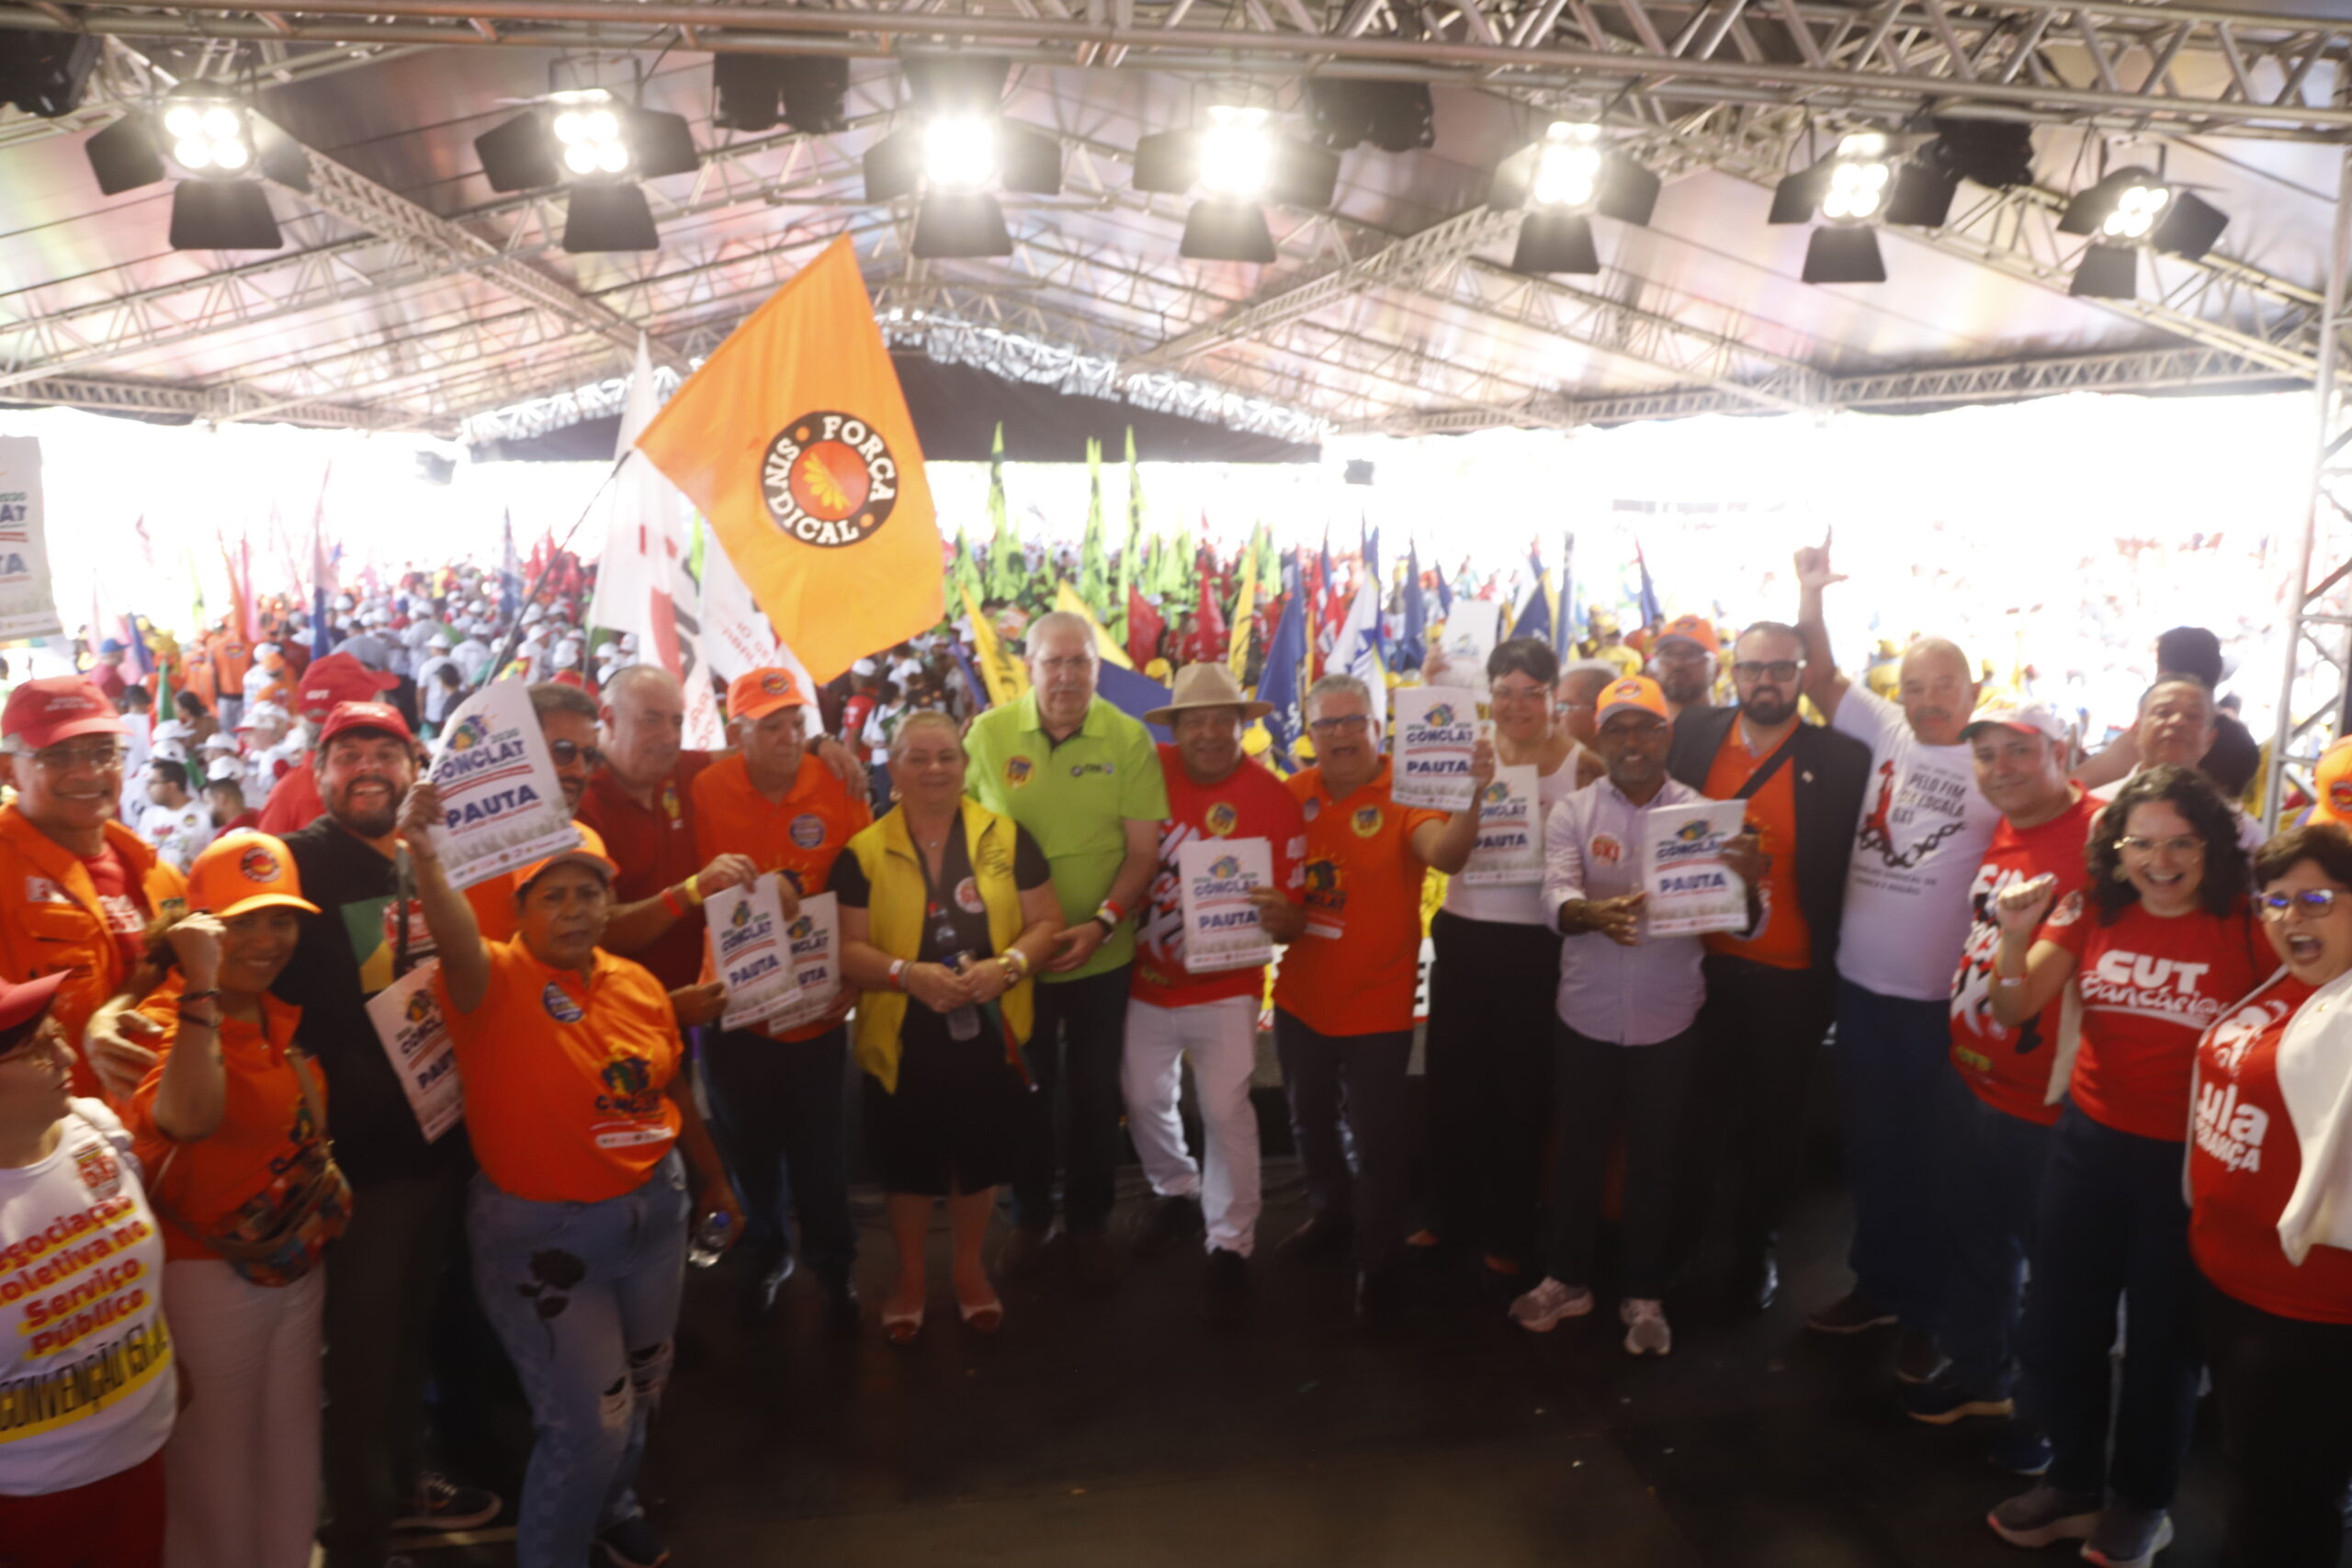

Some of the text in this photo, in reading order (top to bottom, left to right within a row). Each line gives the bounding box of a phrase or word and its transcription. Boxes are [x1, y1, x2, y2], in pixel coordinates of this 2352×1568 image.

[764, 437, 860, 544] SINDICAL
[1407, 730, 1473, 744] CONCLAT
[1407, 760, 1469, 774] PAUTA
[447, 784, 539, 829] PAUTA
[1479, 804, 1528, 818] ONCLAT
[1657, 840, 1719, 860] CONCLA
[1660, 873, 1727, 892] PAUTA
[721, 920, 772, 953] CONCLAT
[1199, 910, 1259, 930] PAUTA
[790, 937, 829, 954] NCLAT
[729, 953, 780, 987] PAUTA
[797, 965, 828, 986] UTA
[2097, 949, 2211, 994] CUT
[416, 1045, 455, 1090] PAUT
[2198, 1082, 2270, 1147] ula
[0, 1196, 133, 1271] sociação
[0, 1238, 111, 1302] oletiva
[25, 1258, 140, 1329] Serviço
[31, 1288, 144, 1357] Público
